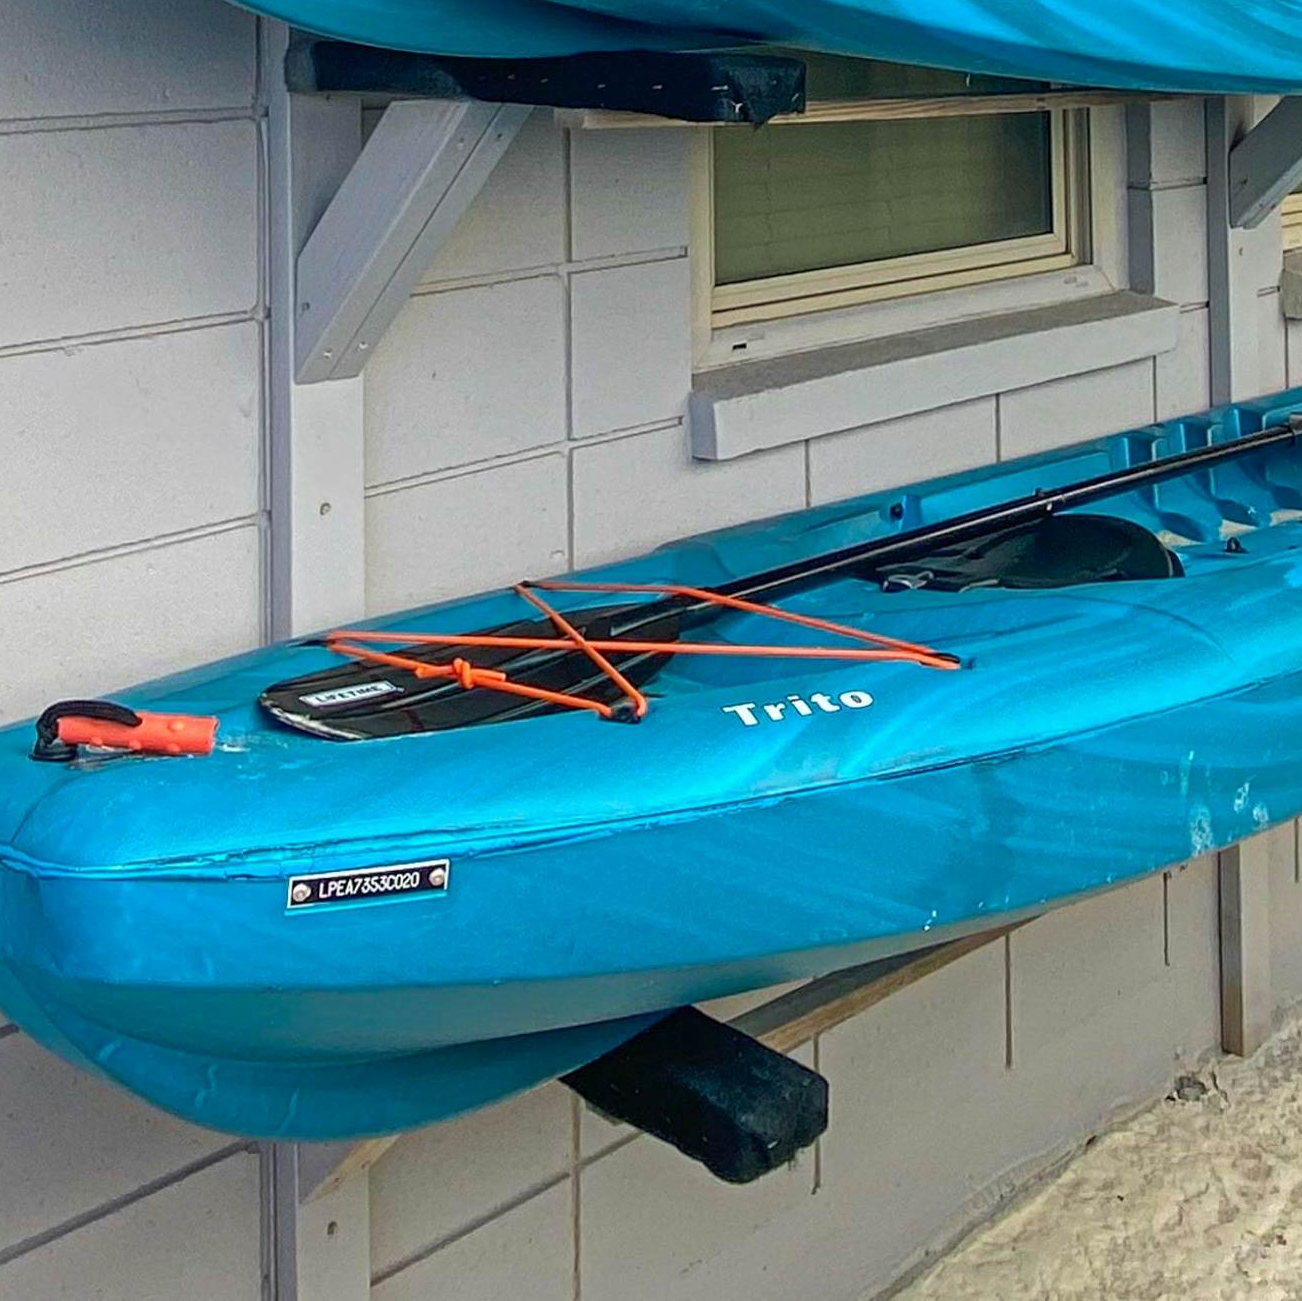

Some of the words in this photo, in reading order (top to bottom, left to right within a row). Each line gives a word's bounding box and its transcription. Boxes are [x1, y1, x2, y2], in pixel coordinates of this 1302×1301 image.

[314, 685, 383, 703] LIFETIME
[721, 691, 874, 727] Trito
[318, 871, 421, 899] LPEA7353C020
